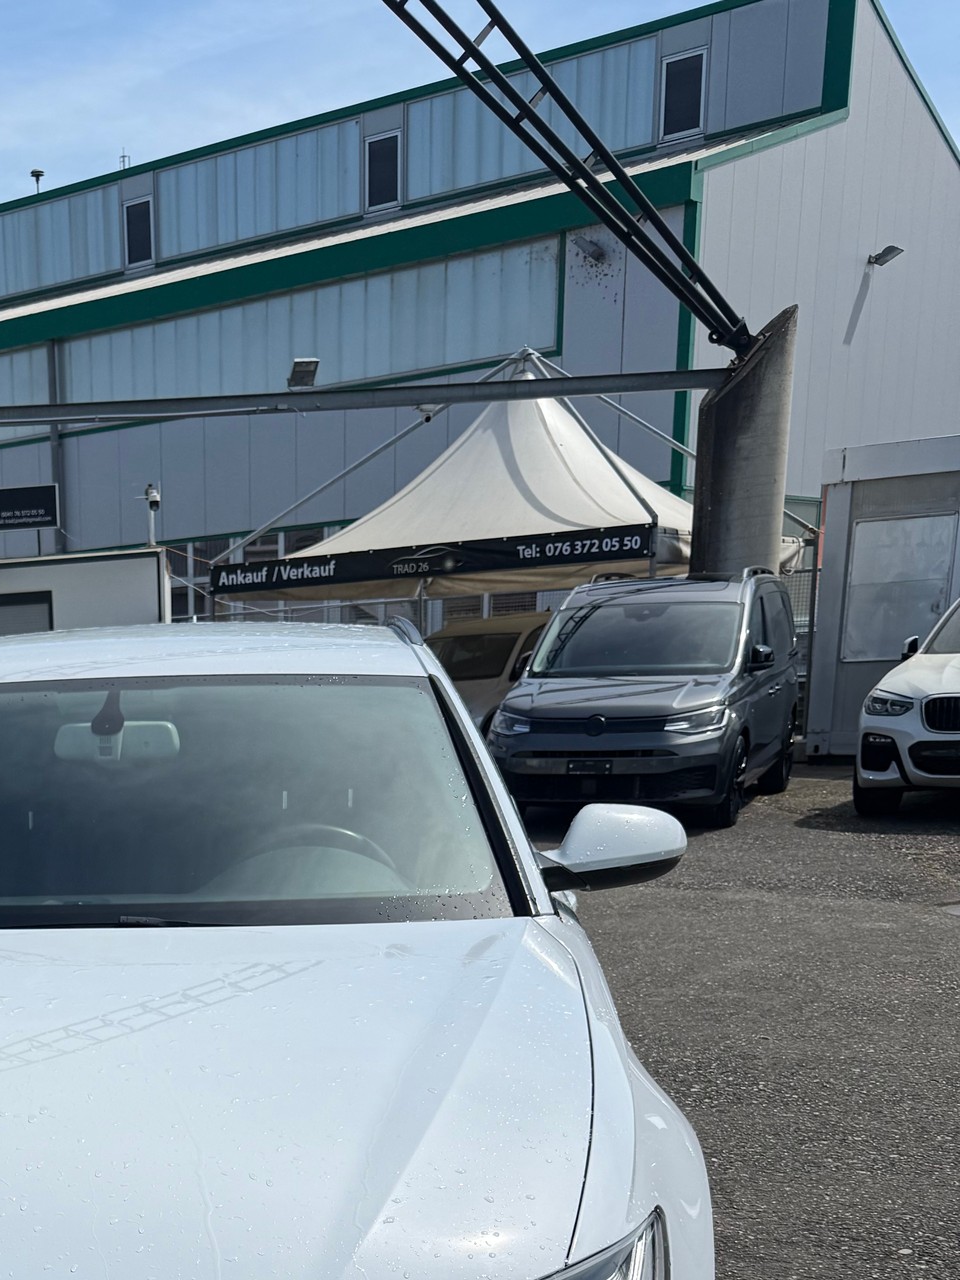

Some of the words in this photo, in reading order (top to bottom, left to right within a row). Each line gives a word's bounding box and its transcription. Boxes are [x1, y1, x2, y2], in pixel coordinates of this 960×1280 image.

[516, 544, 540, 559] Tel:
[545, 542, 571, 557] 076
[573, 539, 599, 554] 372
[602, 538, 620, 551] 05
[622, 536, 641, 550] 50
[218, 567, 268, 587] Ankauf
[392, 563, 417, 575] TRAD
[418, 562, 429, 573] 26
